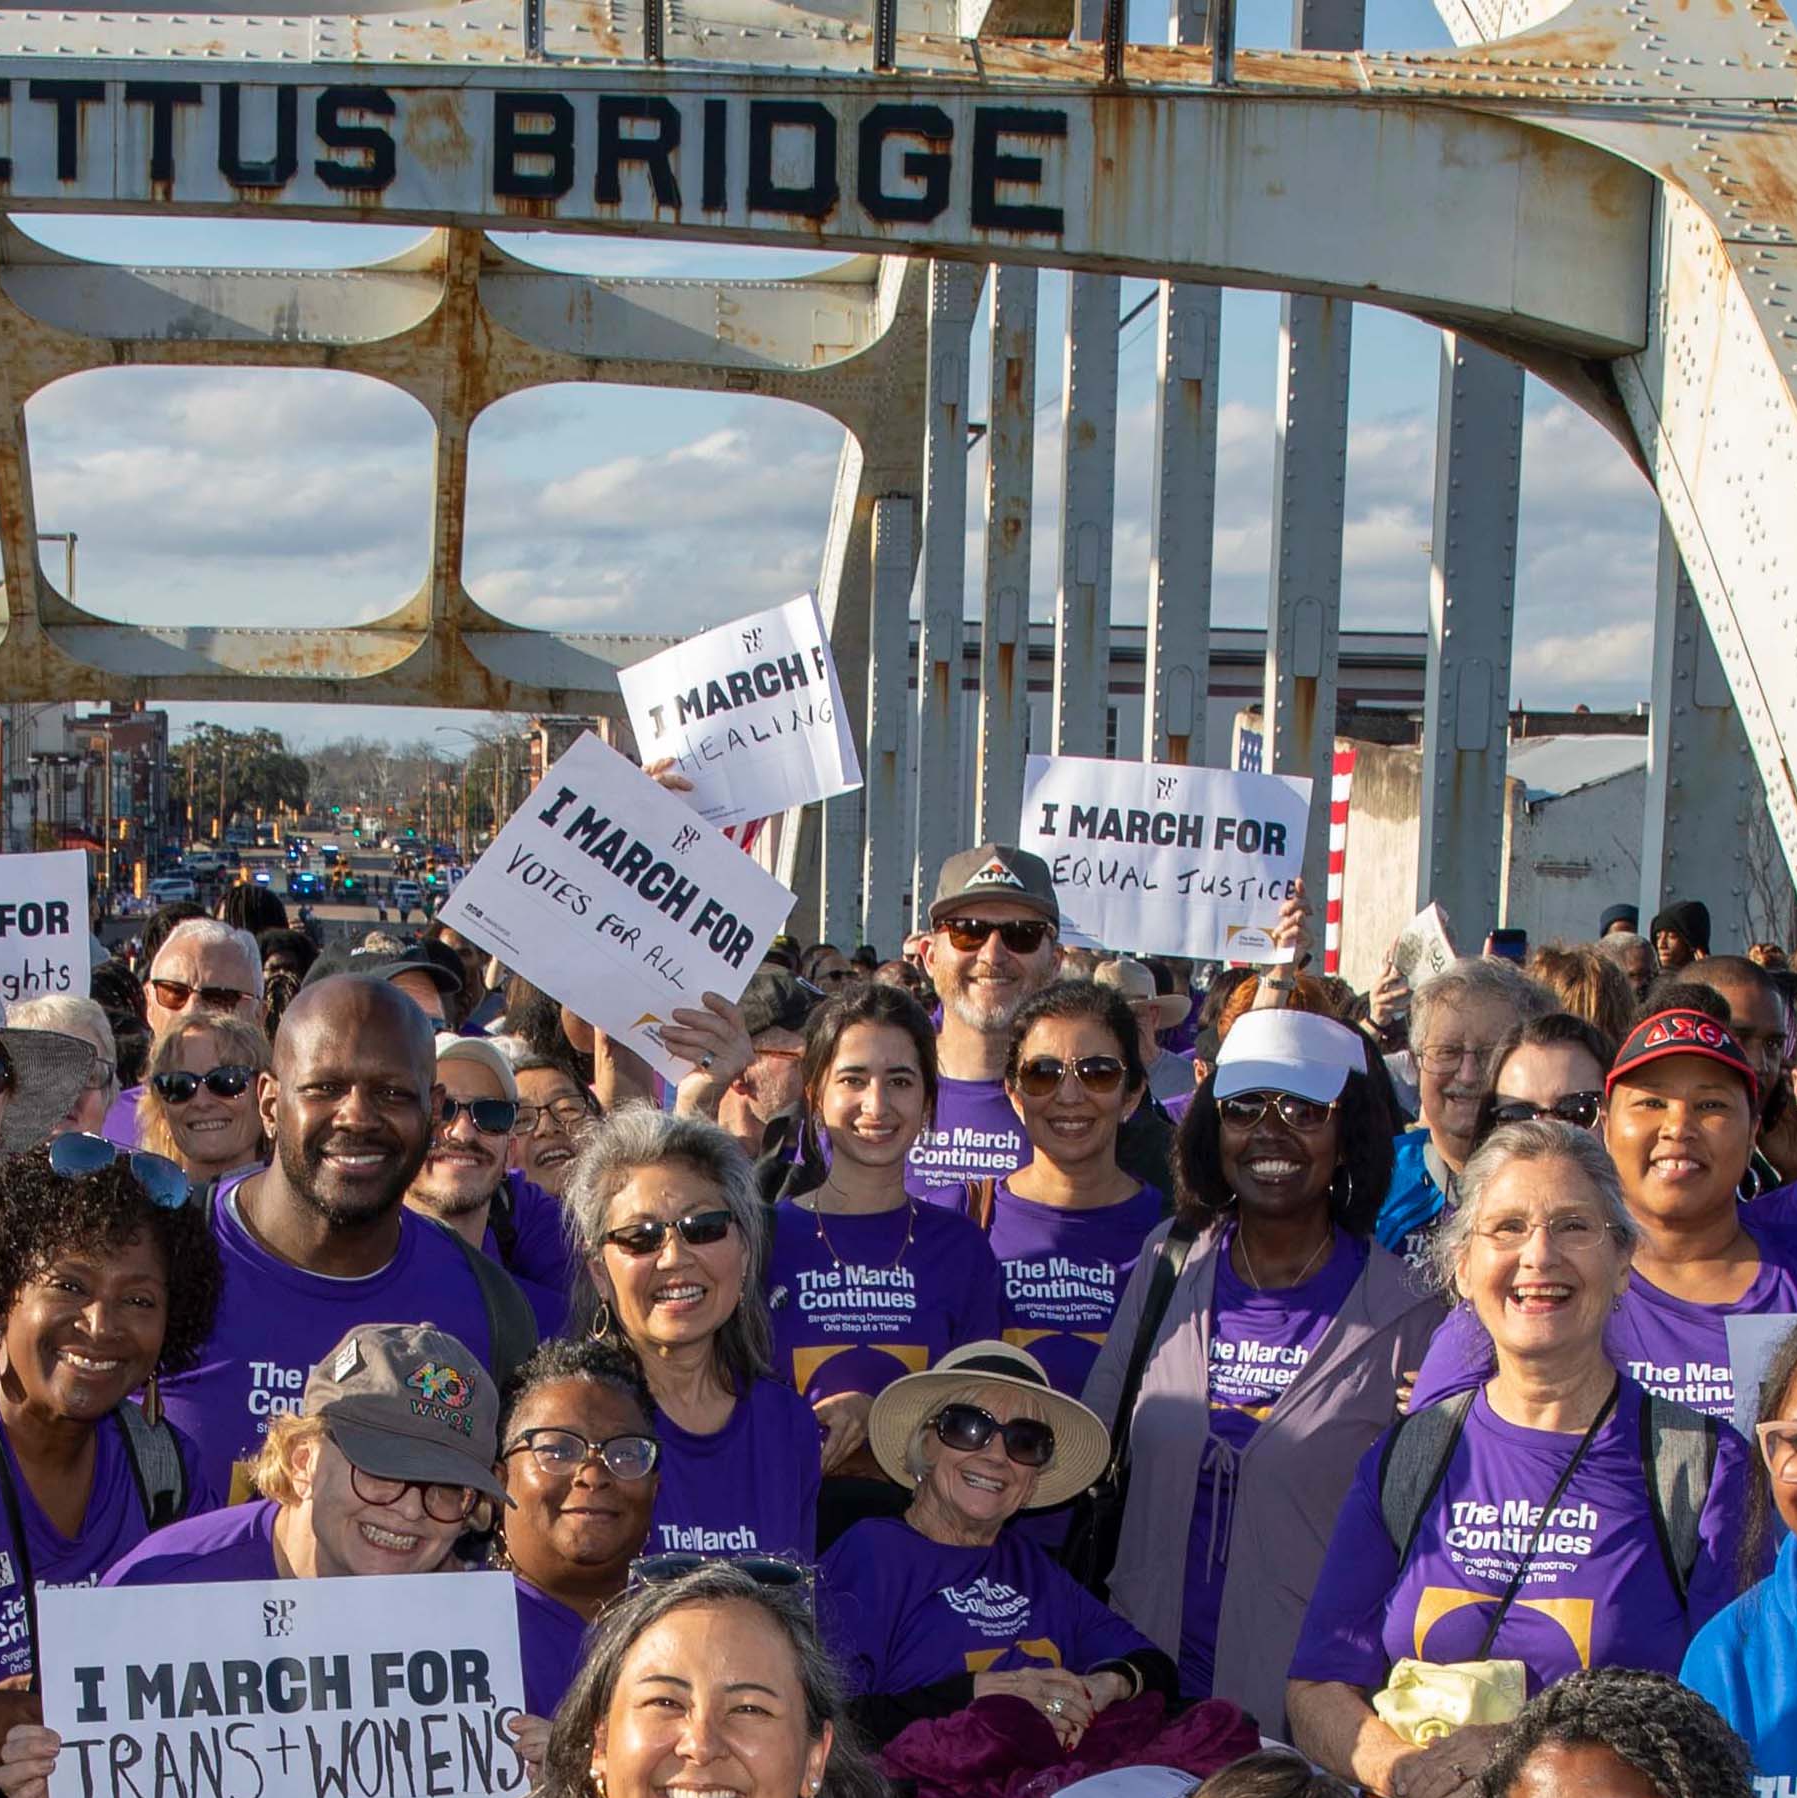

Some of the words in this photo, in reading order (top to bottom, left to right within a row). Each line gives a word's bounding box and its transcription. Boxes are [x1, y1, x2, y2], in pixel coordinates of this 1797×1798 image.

[492, 91, 1068, 234] BRIDGE
[647, 704, 667, 740] I
[675, 656, 811, 726] MARCH
[676, 697, 834, 772] HEALING
[1039, 803, 1059, 835] I
[1068, 804, 1204, 849] MARCH
[1214, 817, 1287, 857] FOR
[537, 786, 574, 827] I
[564, 813, 694, 926] MARCH
[689, 899, 754, 970] FOR
[1052, 854, 1159, 891] EQUAL
[1177, 868, 1297, 902] JUSTICE
[507, 843, 594, 917] VOTES
[596, 911, 641, 953] FOR
[642, 946, 686, 991] ALL
[953, 1127, 1021, 1150] March
[908, 1146, 1018, 1170] Continues
[796, 1269, 841, 1291] The
[845, 1264, 915, 1289] March
[1002, 1260, 1046, 1279] The
[1048, 1258, 1115, 1285] March
[799, 1288, 916, 1310] Continues
[1005, 1278, 1115, 1304] Continues
[1238, 1340, 1309, 1365] March
[248, 1361, 303, 1389] The
[1628, 1361, 1681, 1382] The
[411, 1399, 473, 1430] WWOZ
[1452, 1501, 1500, 1526] The
[1502, 1500, 1598, 1530] March
[1445, 1527, 1593, 1556] Continues
[1464, 1564, 1487, 1579] One
[73, 1666, 108, 1723] I
[124, 1655, 353, 1720] MARCH
[370, 1648, 491, 1708] FOR
